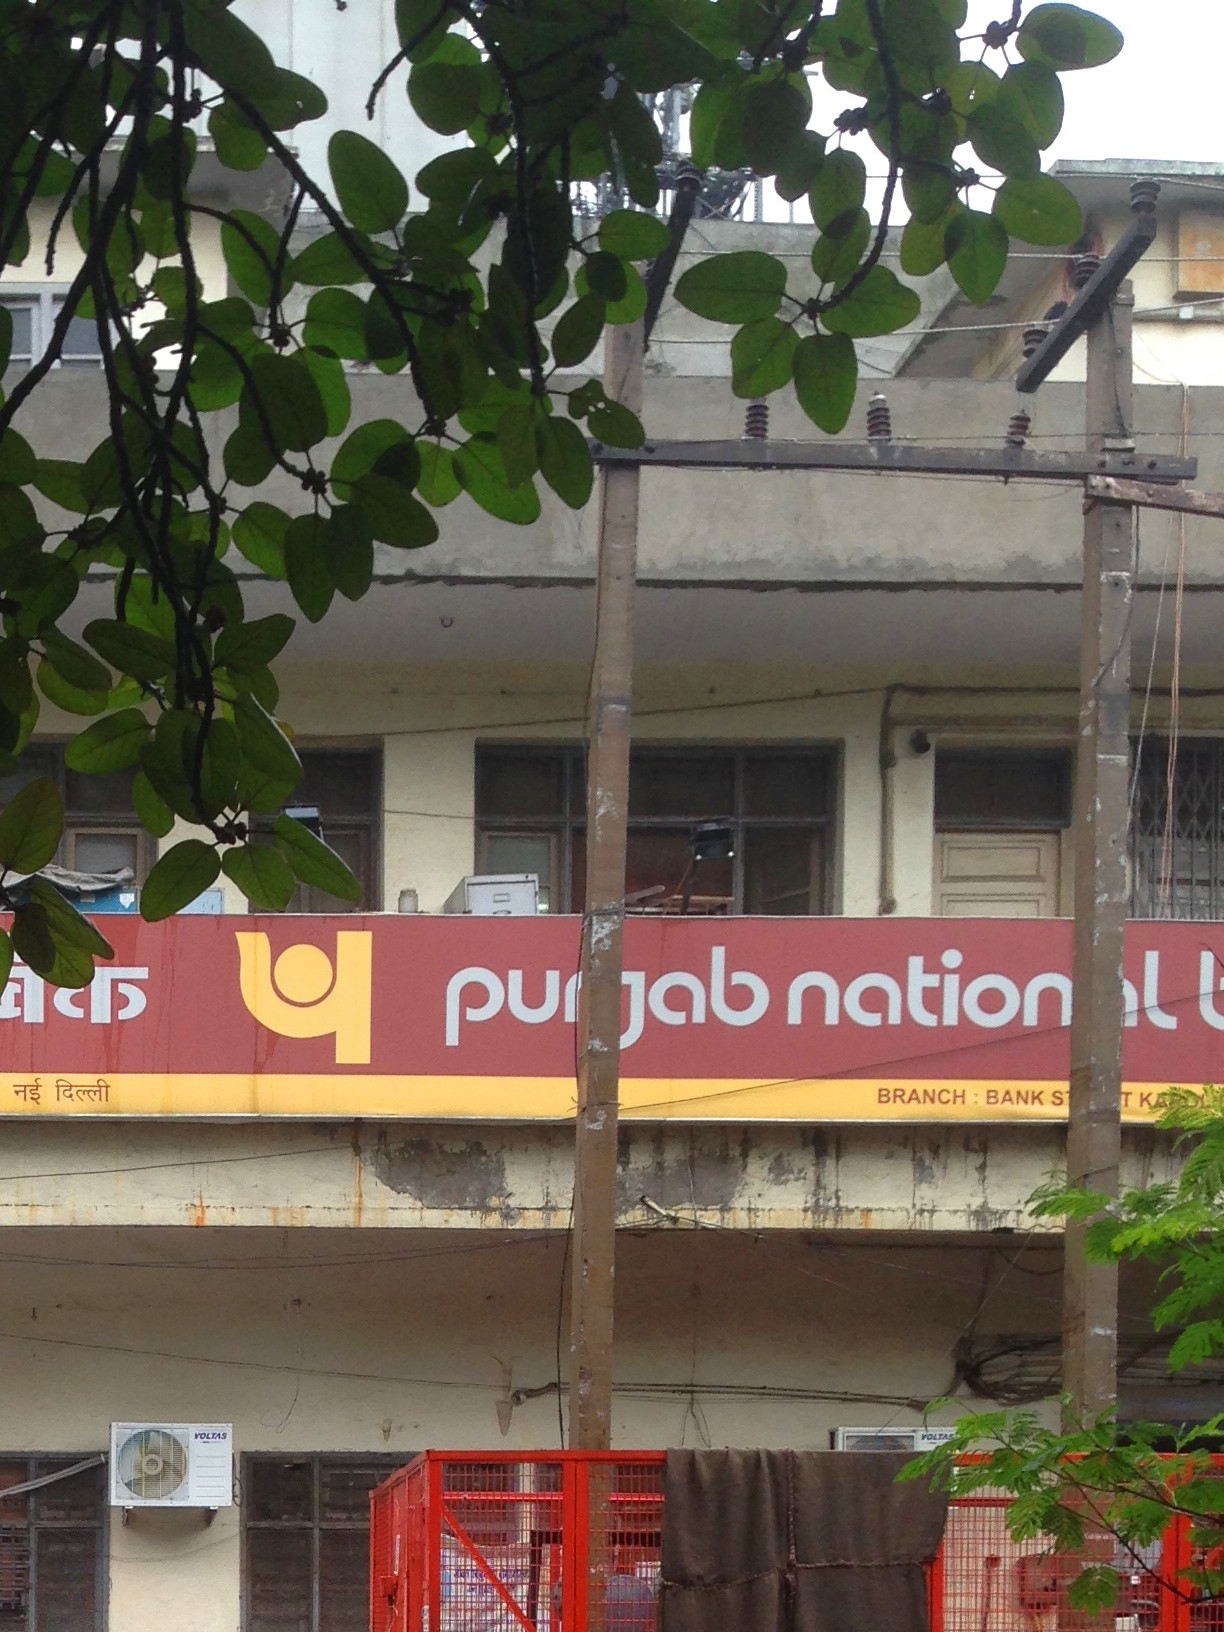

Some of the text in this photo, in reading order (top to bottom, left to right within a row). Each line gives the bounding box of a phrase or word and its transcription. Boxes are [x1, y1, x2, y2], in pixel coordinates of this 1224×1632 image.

[787, 949, 1178, 1030] nationl
[13, 1077, 43, 1102] नई
[55, 1077, 111, 1102] दिल्ली
[877, 1088, 966, 1105] BRANCH
[987, 1089, 1045, 1106] BANK
[194, 1432, 227, 1440] VOLTAS
[921, 1433, 954, 1441] VOLTAS
